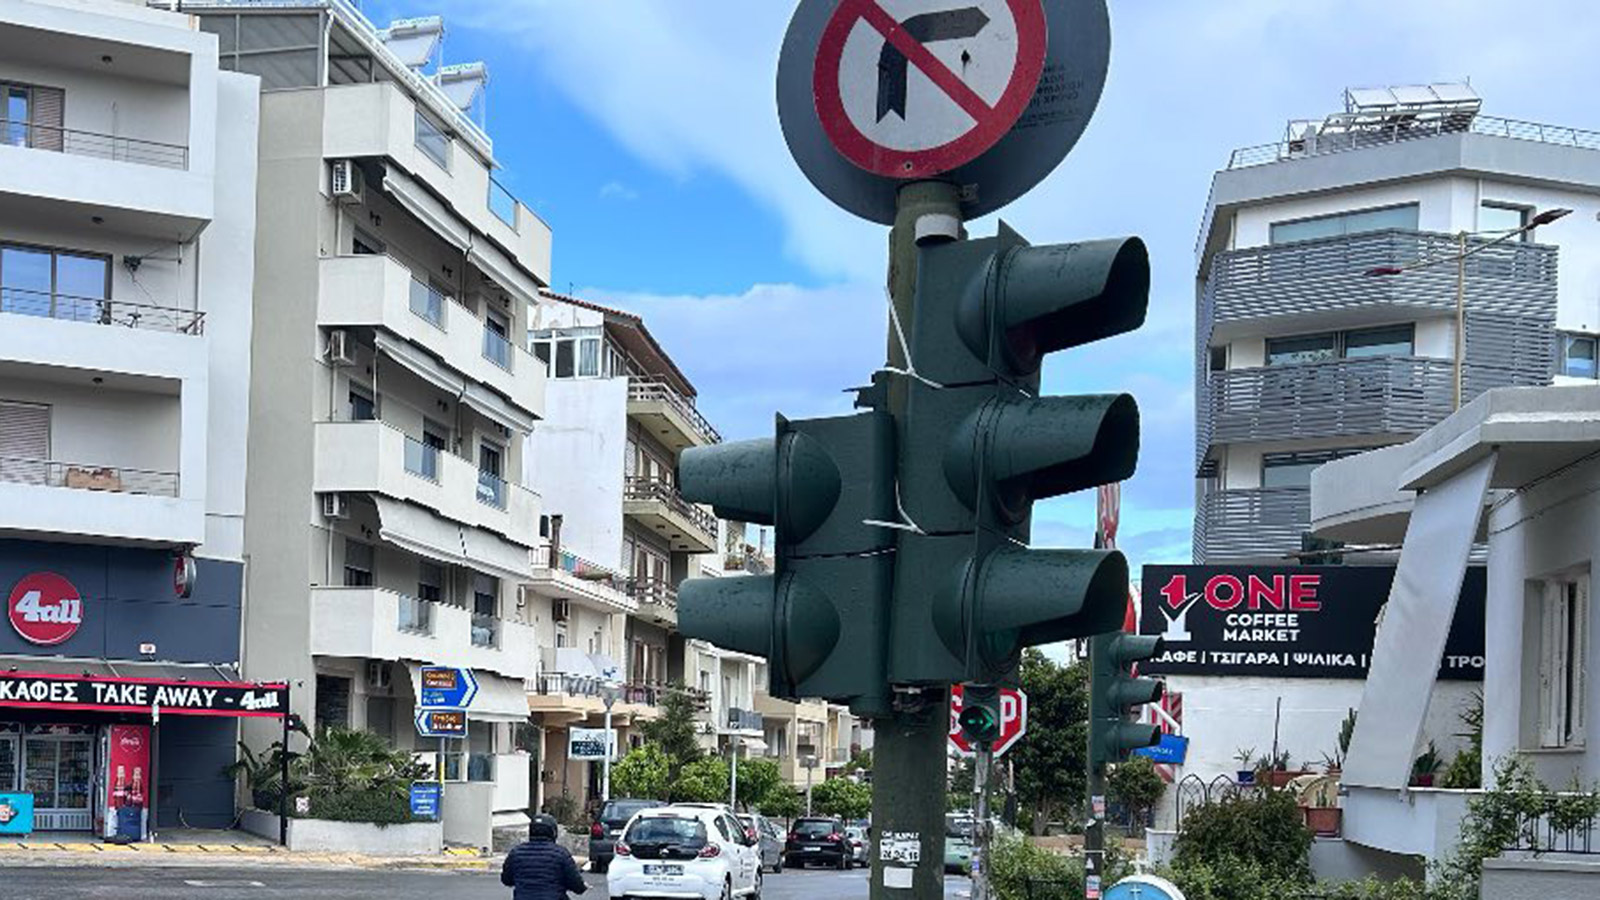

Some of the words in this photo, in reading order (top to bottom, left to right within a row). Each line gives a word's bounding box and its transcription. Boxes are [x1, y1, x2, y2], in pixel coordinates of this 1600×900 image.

[15, 590, 82, 624] 4all
[1204, 574, 1322, 611] ONE
[1223, 628, 1301, 642] MARKET
[1226, 613, 1299, 628] COFFEE
[1149, 650, 1196, 663] ΑΦΕ
[1210, 651, 1280, 665] ΤΣΙΓΑΡΑ
[1294, 652, 1356, 667] ΨΙΛΙΚΑ
[0, 680, 78, 701] ΚΑΦΕΣ
[91, 683, 147, 705] TAKE
[153, 686, 217, 708] AWAY
[240, 690, 279, 710] 4all
[949, 694, 1017, 737] SP
